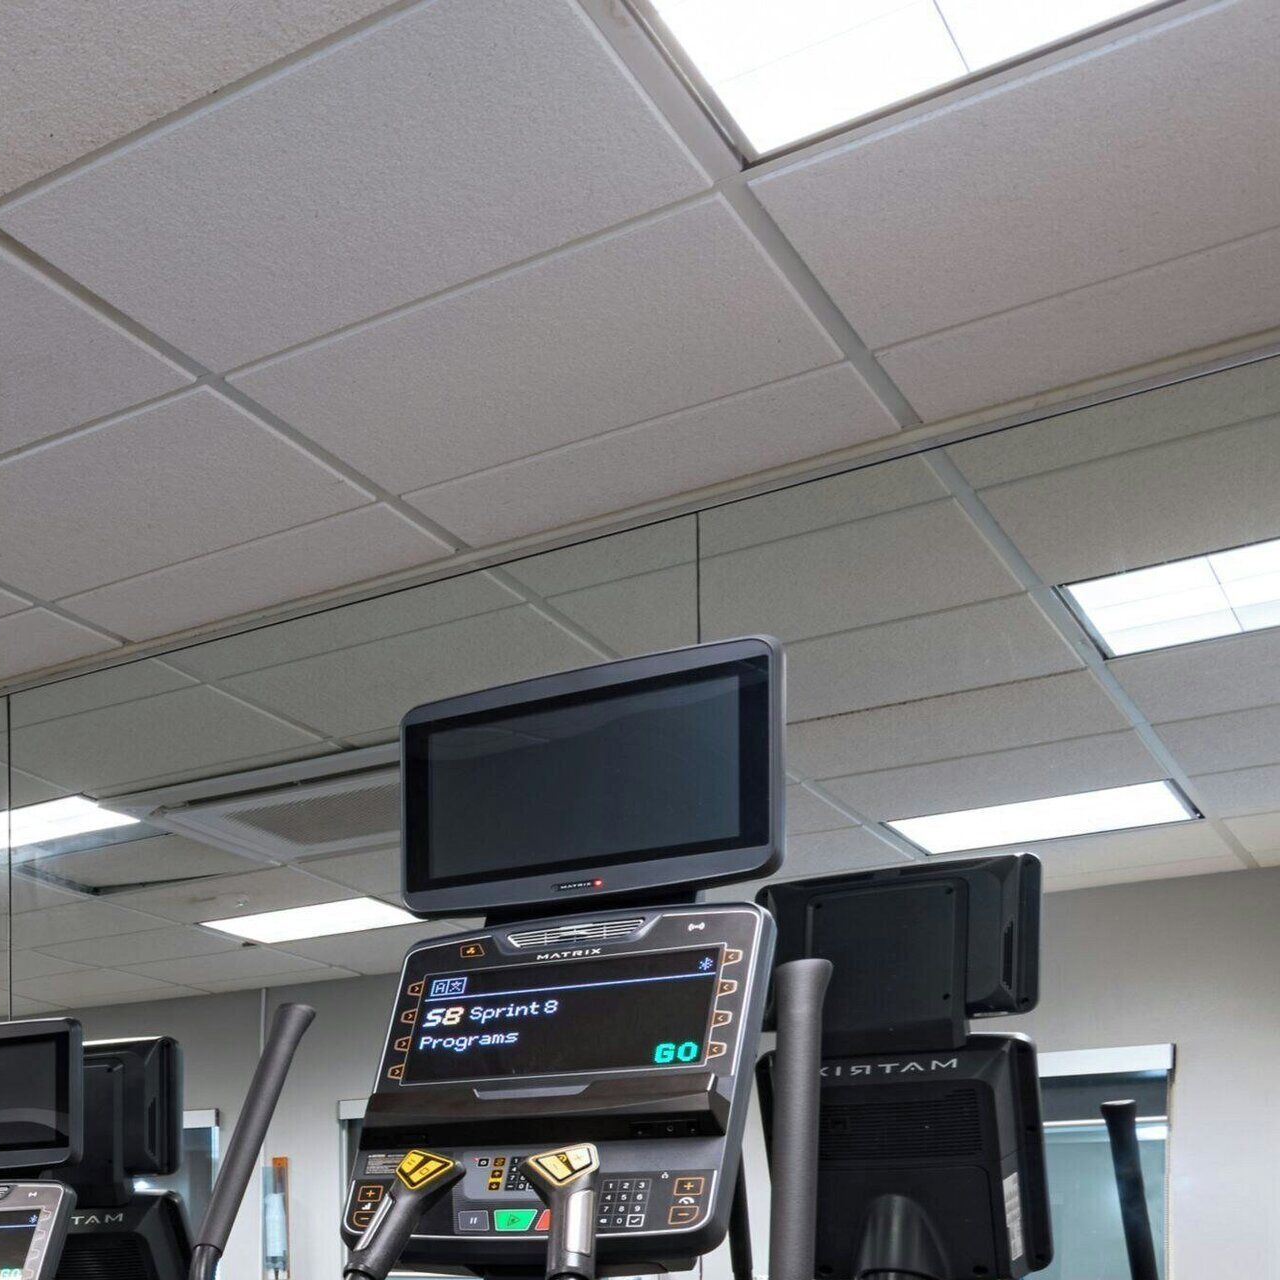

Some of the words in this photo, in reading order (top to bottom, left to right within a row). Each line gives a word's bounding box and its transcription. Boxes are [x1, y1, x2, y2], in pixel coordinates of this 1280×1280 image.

[537, 948, 602, 960] MATRIX
[422, 1006, 466, 1028] S8
[469, 1002, 540, 1024] Sprint
[543, 1000, 559, 1014] 8
[419, 1031, 519, 1051] Programs
[653, 1042, 699, 1064] GO
